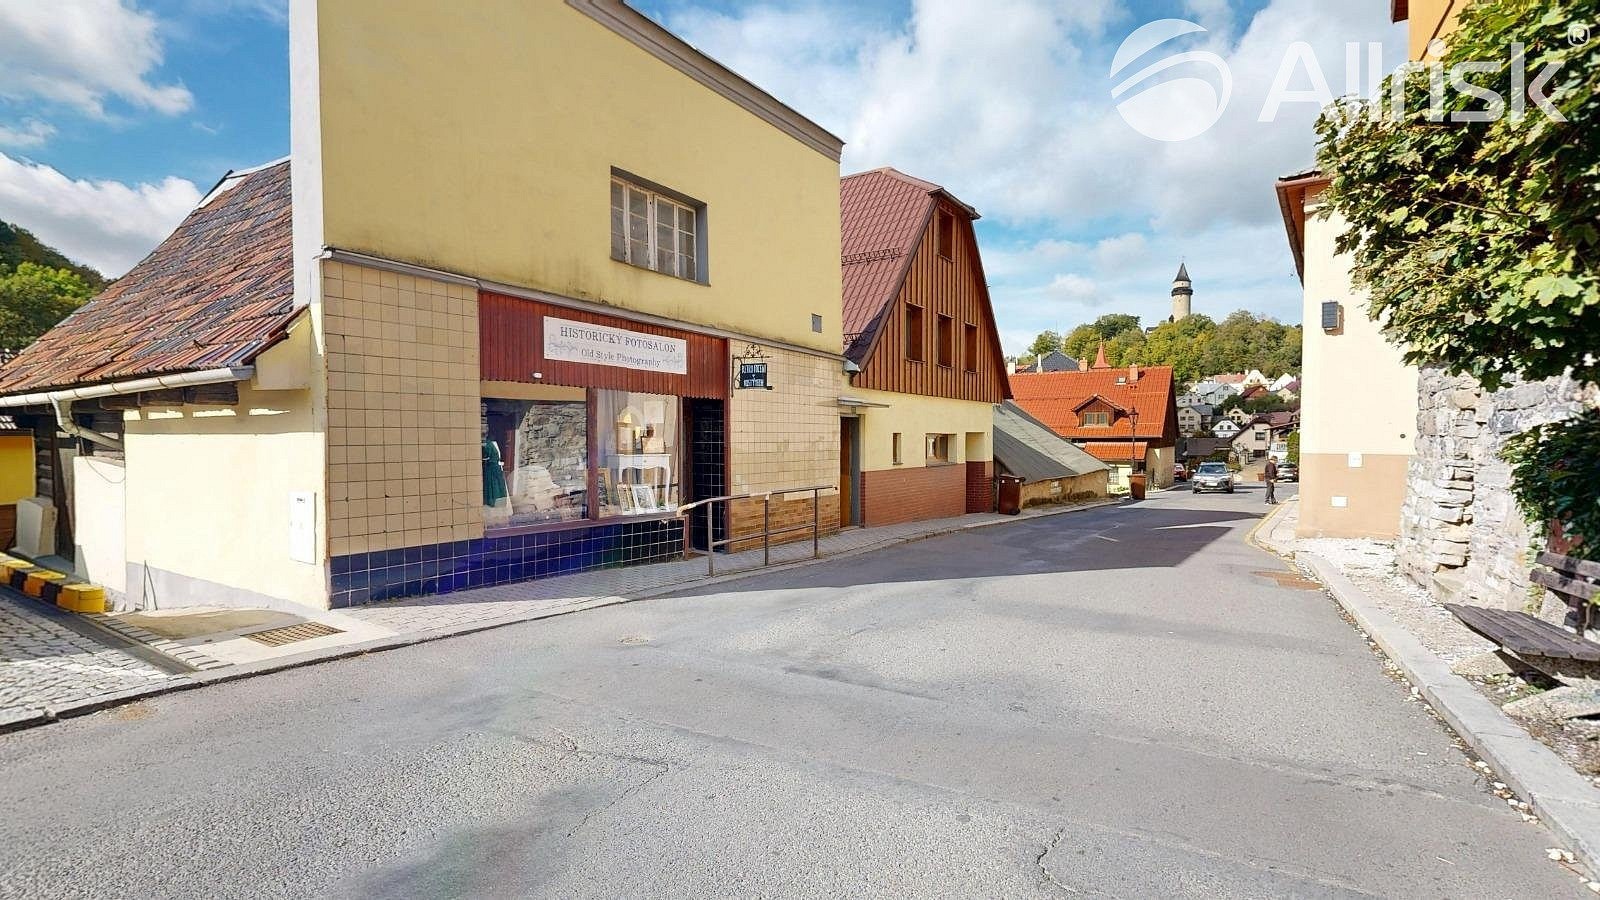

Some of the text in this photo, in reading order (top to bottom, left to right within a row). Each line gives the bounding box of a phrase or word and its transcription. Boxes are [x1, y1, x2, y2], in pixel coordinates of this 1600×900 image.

[560, 326, 676, 352] HISTORICKÝ FOTOSALON
[581, 349, 661, 367] Old Style Photography
